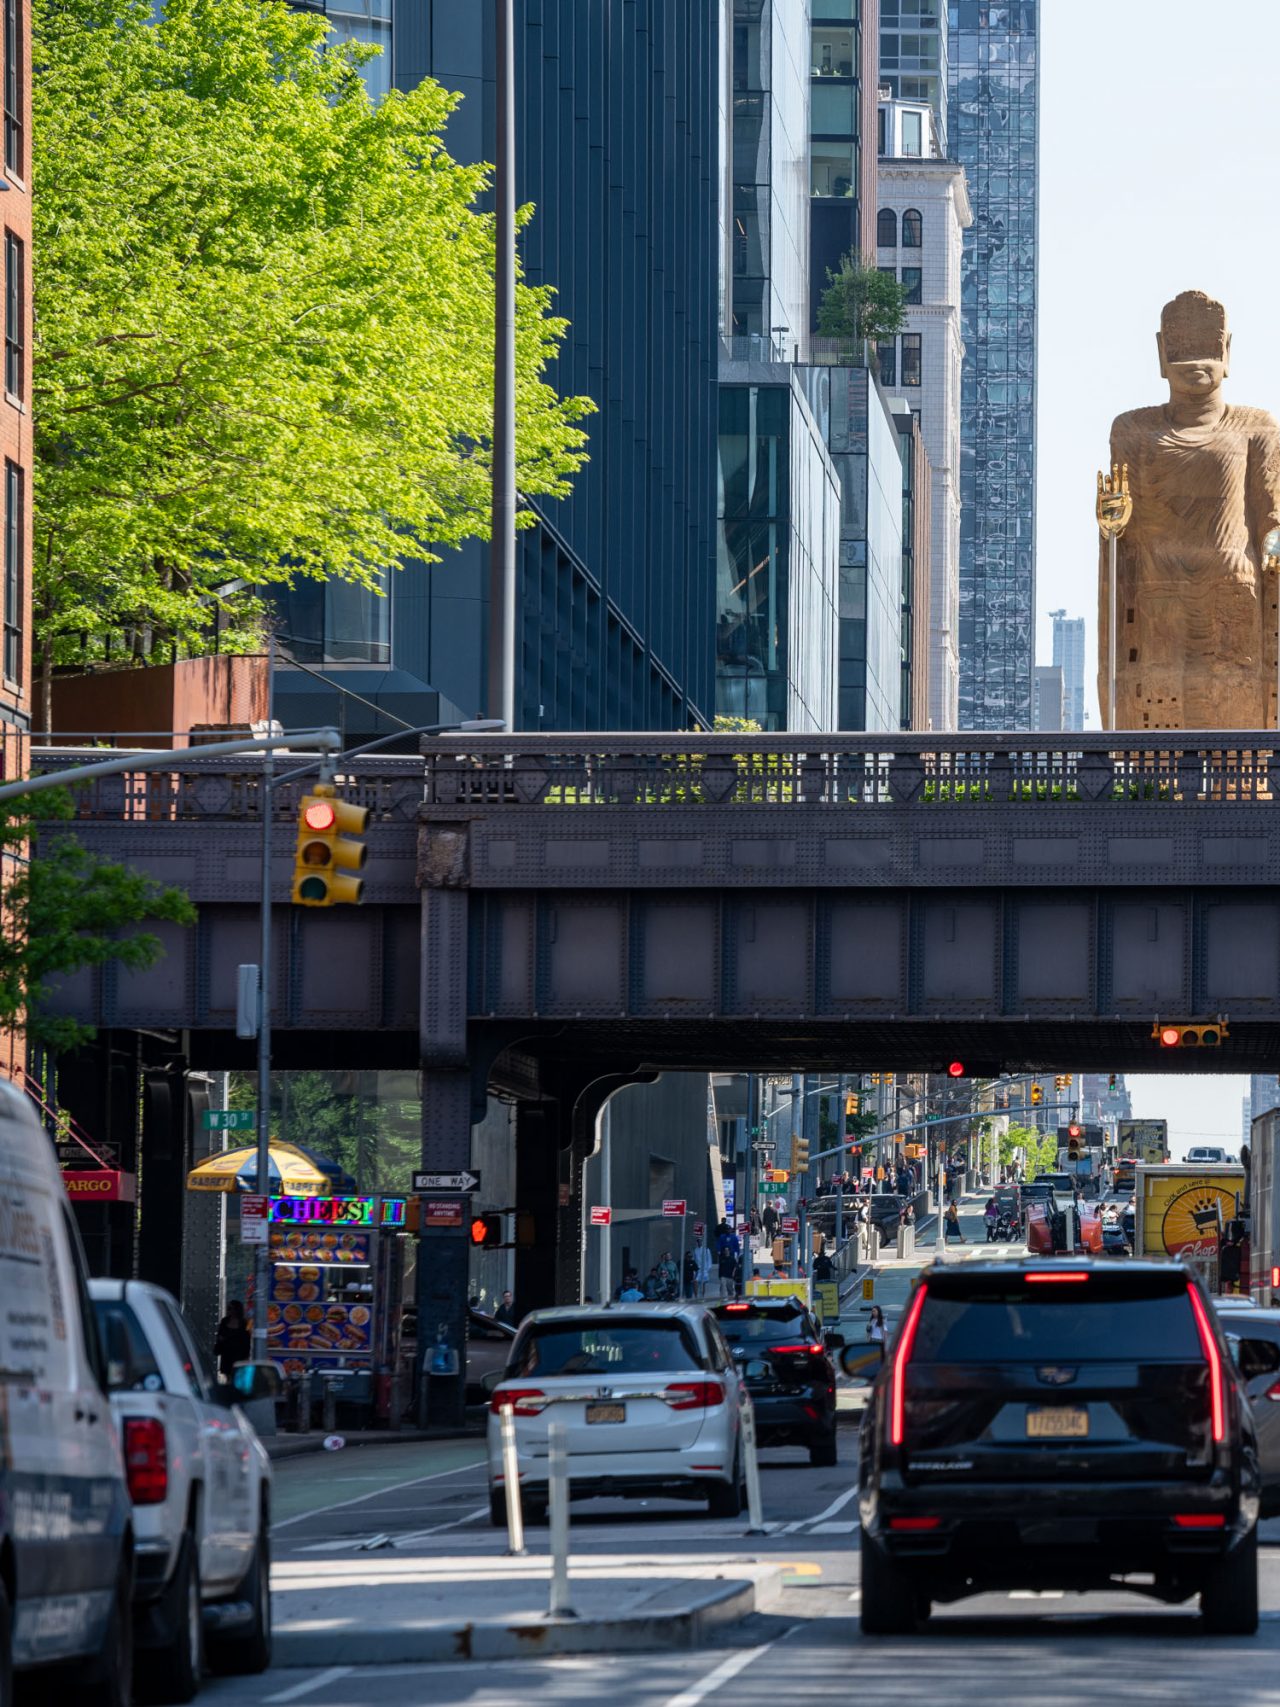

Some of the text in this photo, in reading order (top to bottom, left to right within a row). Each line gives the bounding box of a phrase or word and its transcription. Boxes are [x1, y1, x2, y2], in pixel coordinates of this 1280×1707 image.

[209, 1113, 219, 1128] W
[222, 1113, 237, 1128] 30
[190, 1177, 230, 1187] SABRETT
[421, 1176, 471, 1186] ONE WAY
[763, 1183, 770, 1193] W
